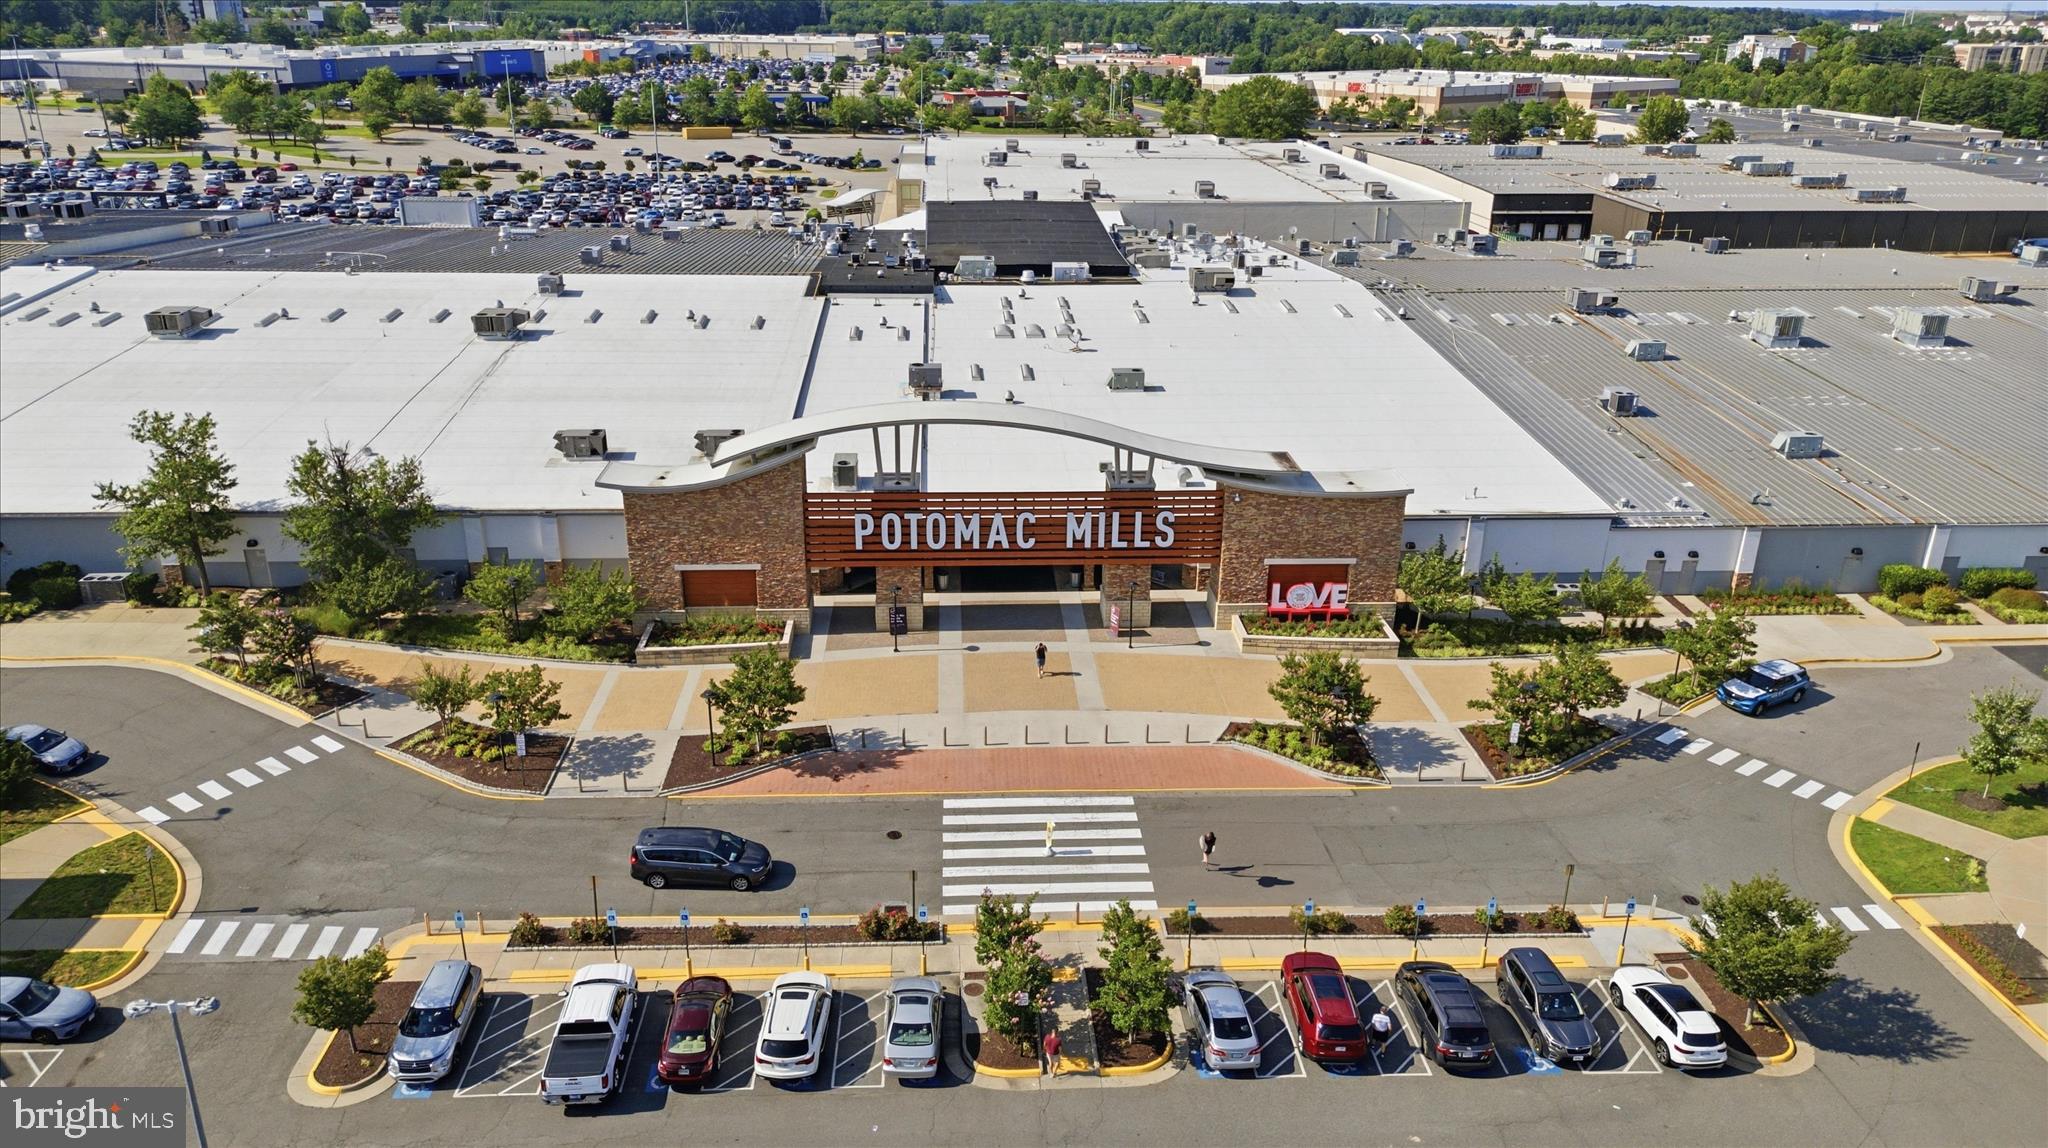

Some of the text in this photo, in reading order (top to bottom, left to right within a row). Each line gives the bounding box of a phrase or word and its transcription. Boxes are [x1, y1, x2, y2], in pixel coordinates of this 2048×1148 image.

[854, 510, 1176, 551] POTOMAC MILLS
[1271, 582, 1348, 610] LOVE
